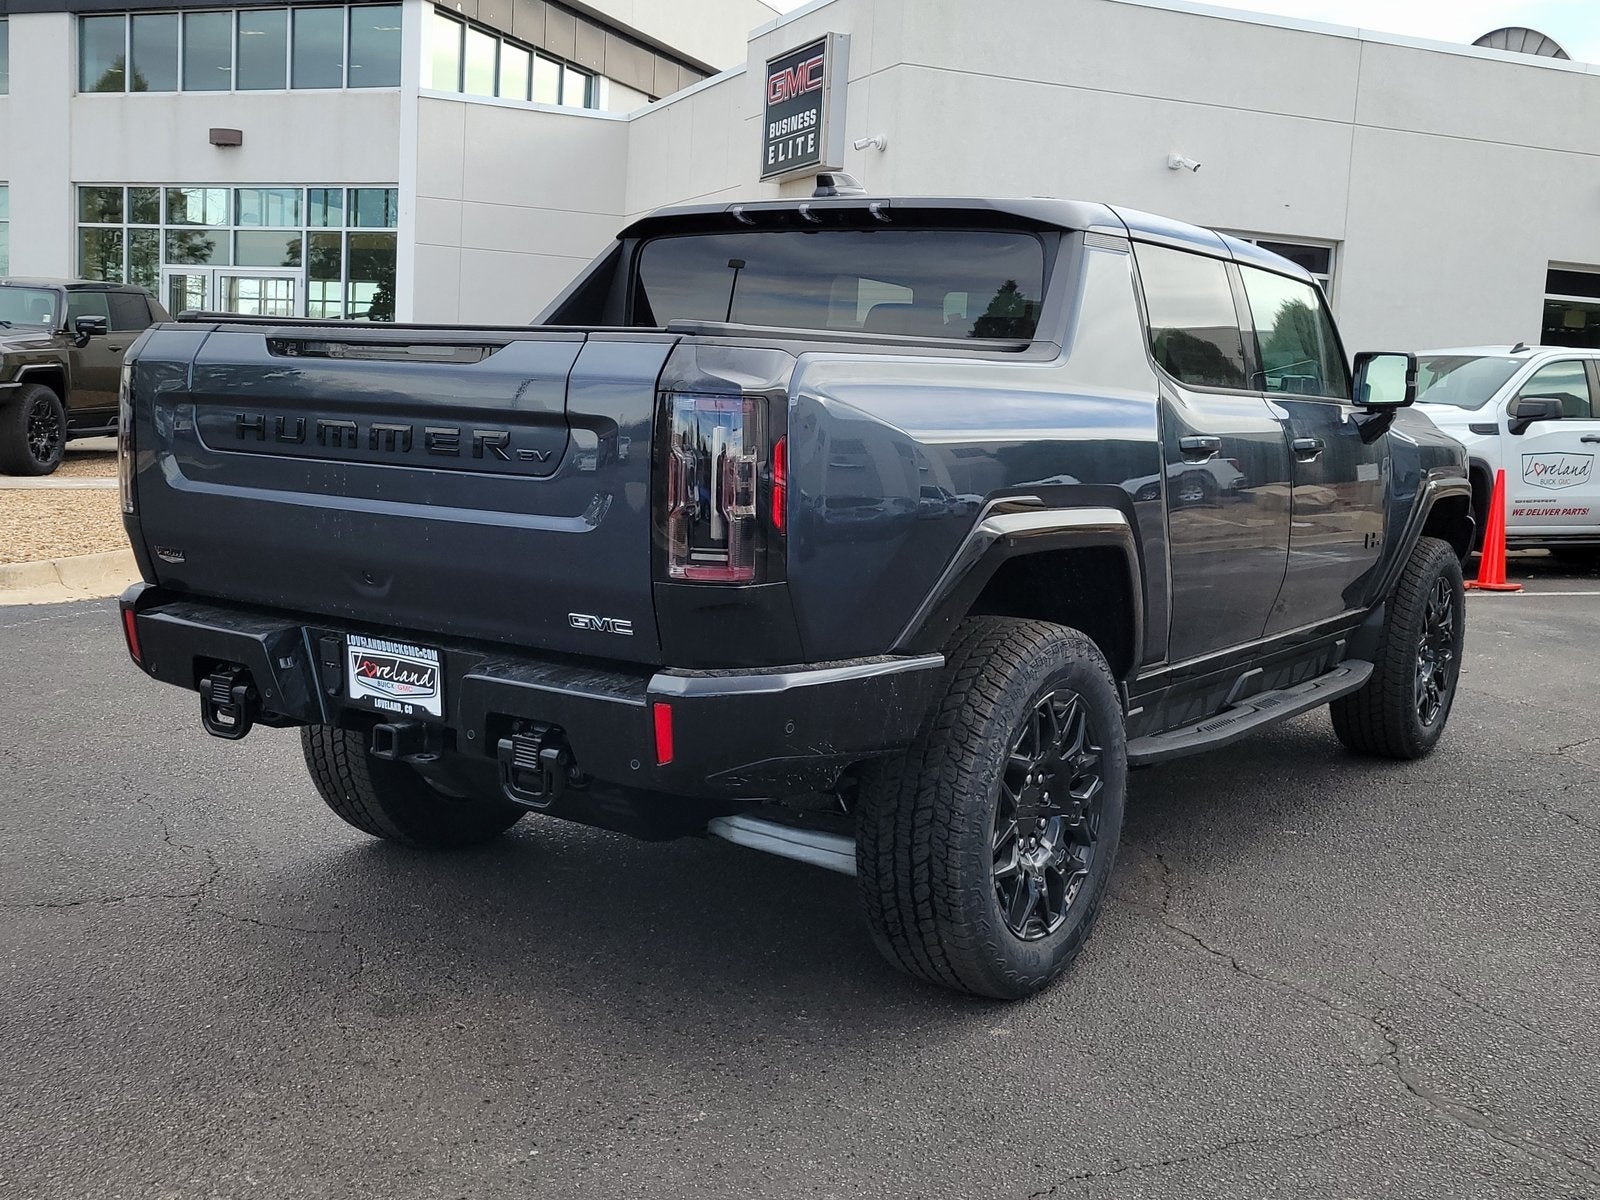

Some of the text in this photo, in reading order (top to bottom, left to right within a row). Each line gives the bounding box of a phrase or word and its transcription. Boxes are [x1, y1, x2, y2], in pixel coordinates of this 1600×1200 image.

[768, 54, 824, 105] GMC
[769, 108, 817, 139] BUSINESS
[768, 132, 815, 165] ELITE
[236, 413, 552, 463] HUMMER EV
[1525, 456, 1590, 477] Loveland
[1512, 507, 1590, 516] WE DELIVER PARTS!
[568, 613, 634, 635] GMC
[354, 652, 434, 687] Loveland
[377, 680, 414, 693] BUICK GMC
[404, 704, 413, 715] CO
